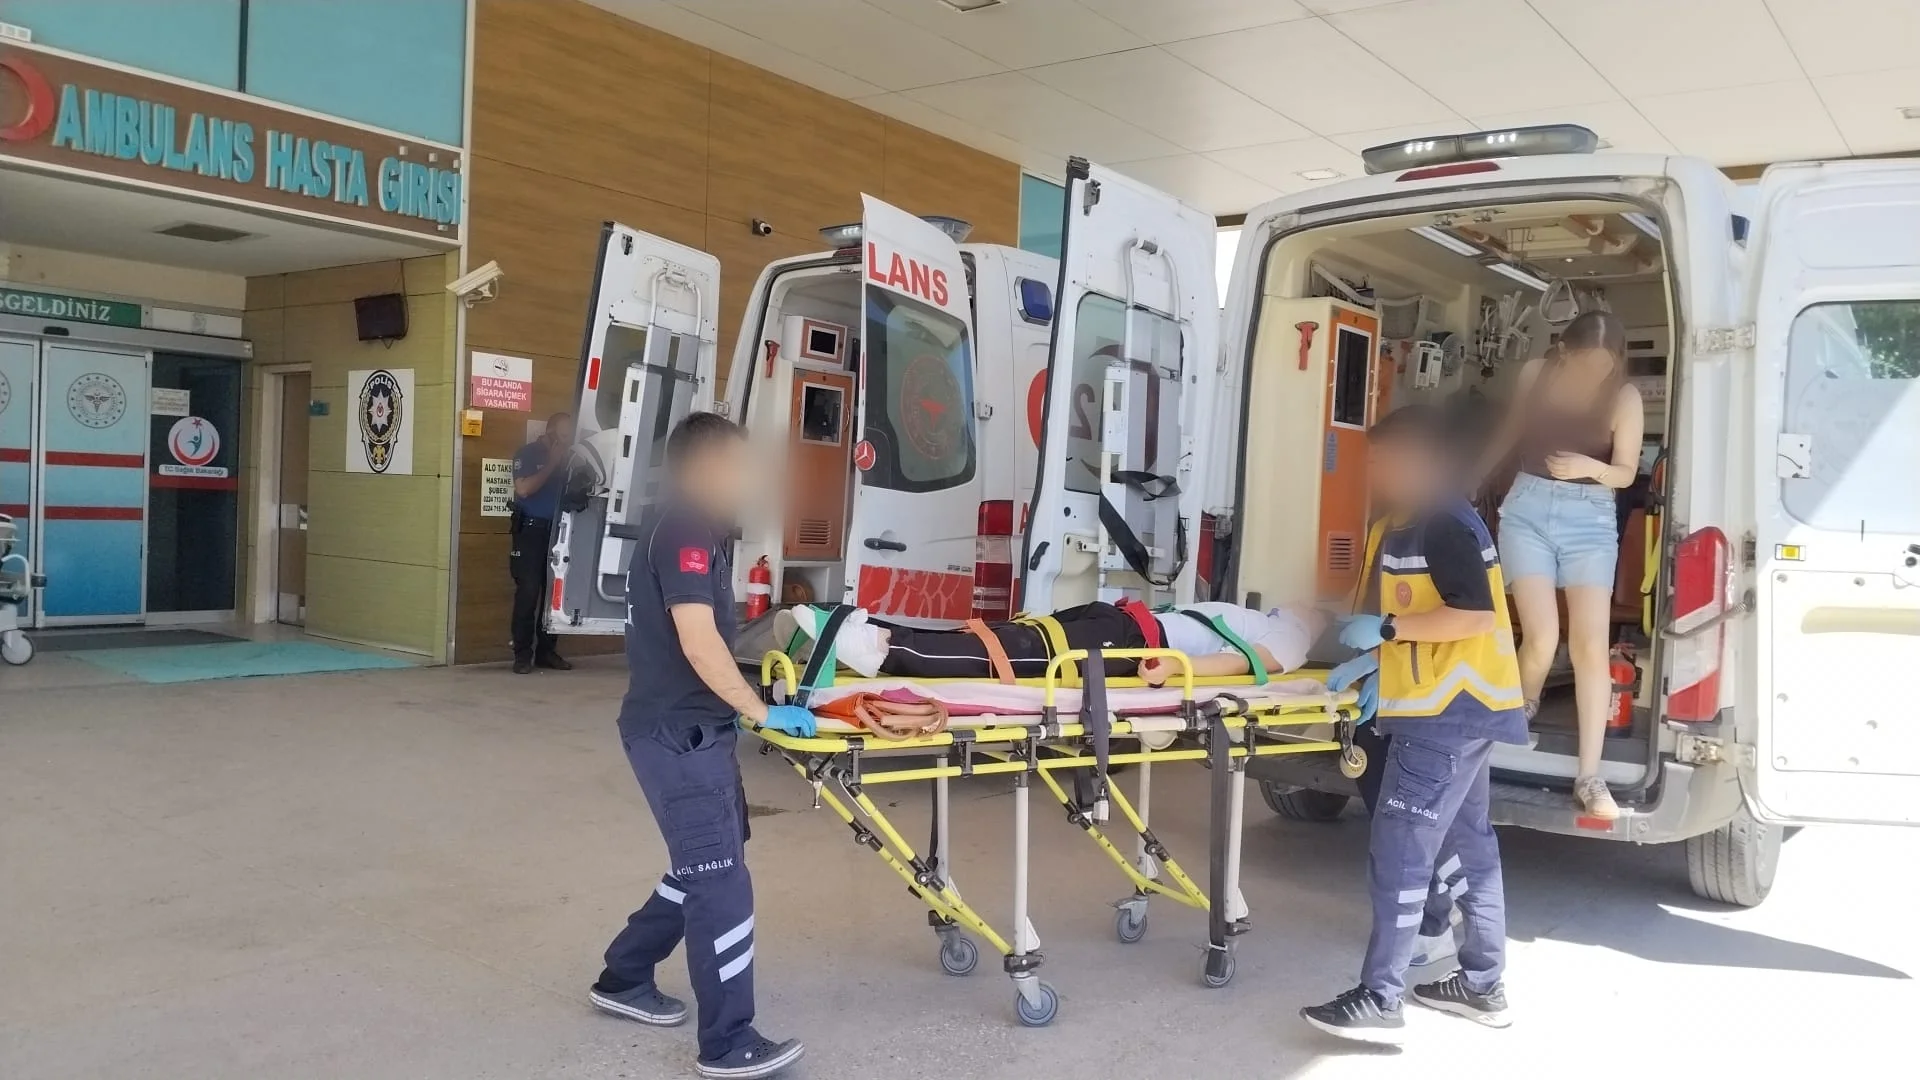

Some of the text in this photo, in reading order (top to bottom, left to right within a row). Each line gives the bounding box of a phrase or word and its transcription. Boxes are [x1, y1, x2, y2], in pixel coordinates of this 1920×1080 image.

[53, 84, 461, 231] AMBULANS HASTA GİRİŞİ
[868, 241, 949, 307] LANS
[0, 292, 111, 321] GELDİNİZ
[481, 378, 522, 390] BU ALANDA
[476, 387, 527, 401] SİGARA İÇMEK
[484, 398, 519, 409] YASAKTIR
[484, 463, 512, 473] ALO TAKS
[486, 477, 512, 485] HASTANE
[698, 858, 734, 872] SAĞLIK
